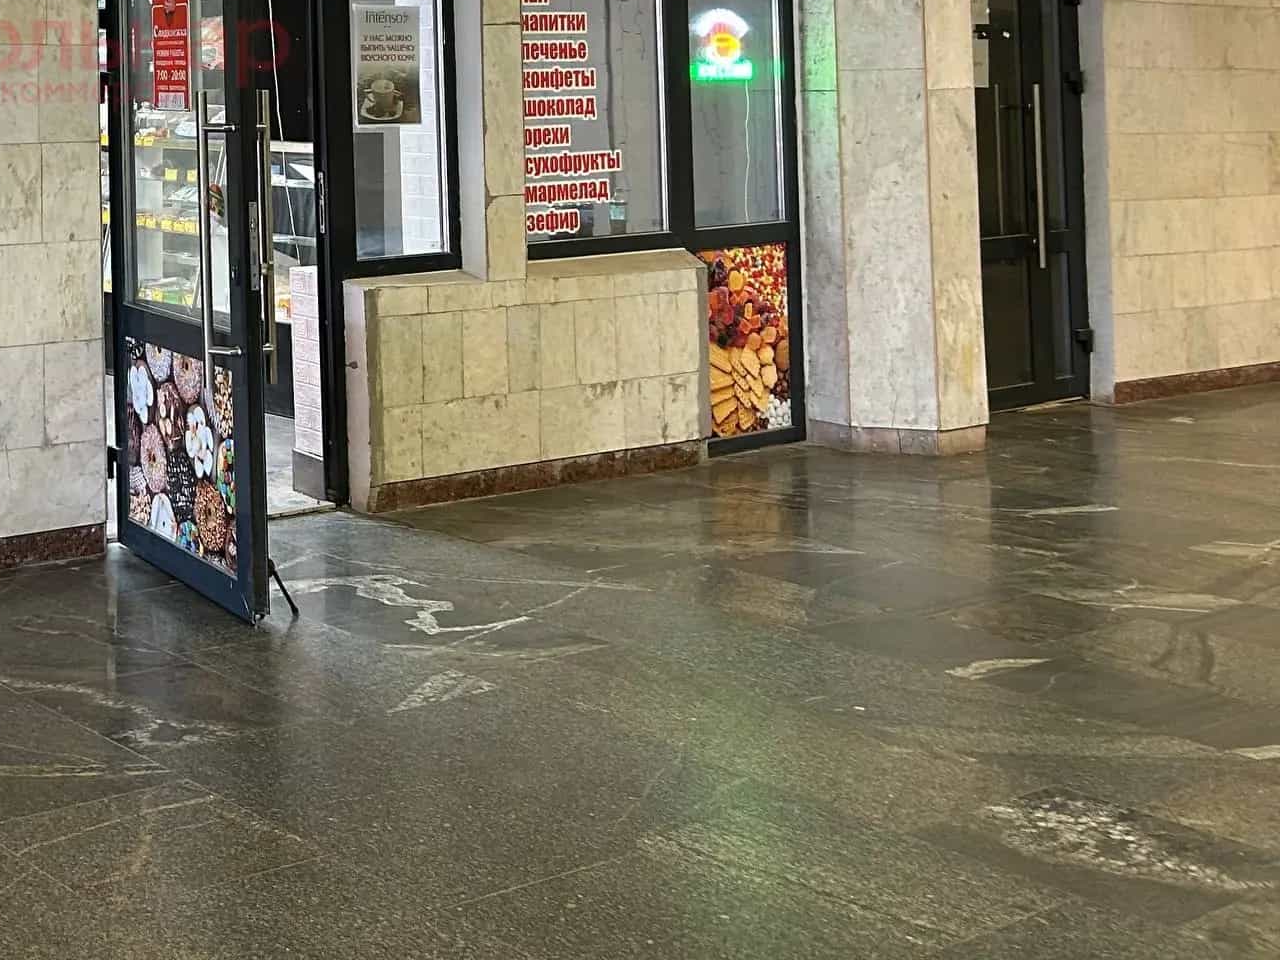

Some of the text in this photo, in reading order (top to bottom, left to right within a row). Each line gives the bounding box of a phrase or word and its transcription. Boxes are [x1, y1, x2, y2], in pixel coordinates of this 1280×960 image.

[521, 13, 586, 32] напитки
[522, 41, 587, 60] печенье
[523, 68, 595, 89] конфеты
[524, 97, 596, 117] шоколад
[525, 127, 570, 147] орехи
[526, 151, 621, 174] сухофрукты
[524, 181, 609, 204] мармелад
[527, 210, 579, 232] зефир
